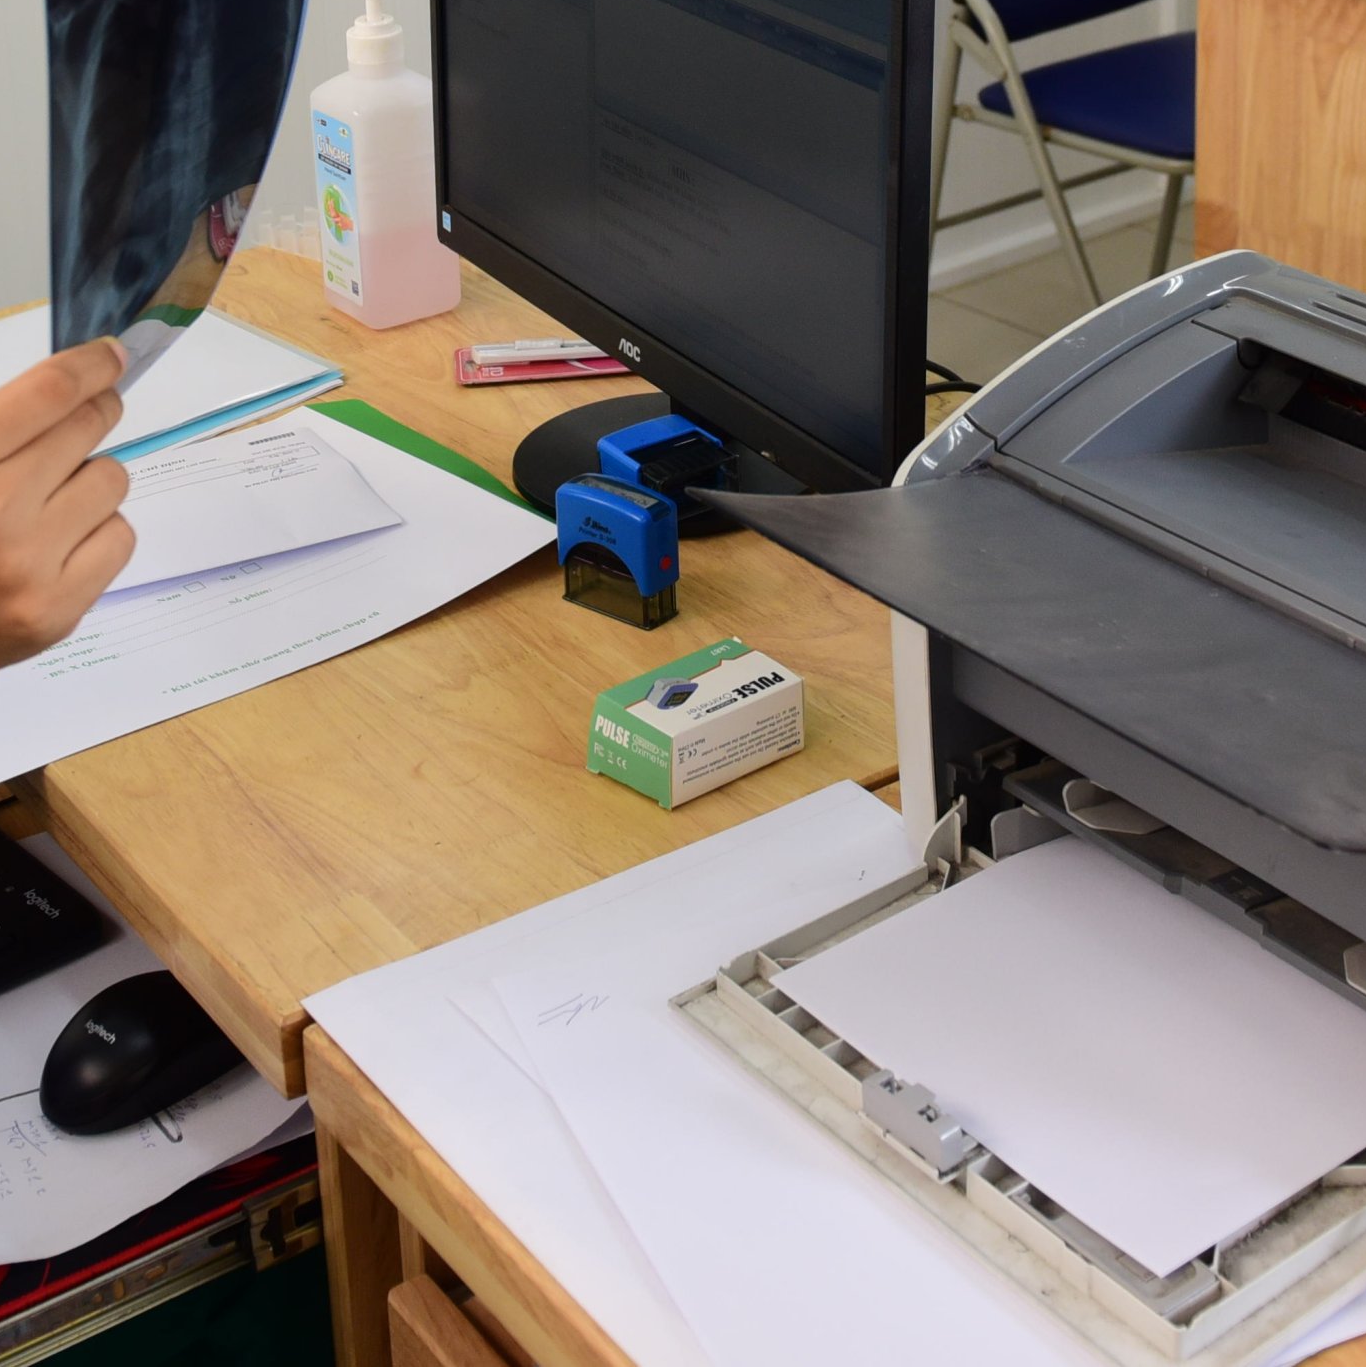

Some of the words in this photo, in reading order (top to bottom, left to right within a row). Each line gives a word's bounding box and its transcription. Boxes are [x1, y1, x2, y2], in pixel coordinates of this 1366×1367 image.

[618, 337, 642, 363] AOC
[262, 648, 292, 662] mang
[292, 638, 314, 650] theo
[315, 628, 342, 642] phim
[731, 671, 786, 700] PULSE
[595, 713, 631, 749] PULSE
[24, 888, 60, 920] logitech
[85, 1019, 117, 1045] logitech
